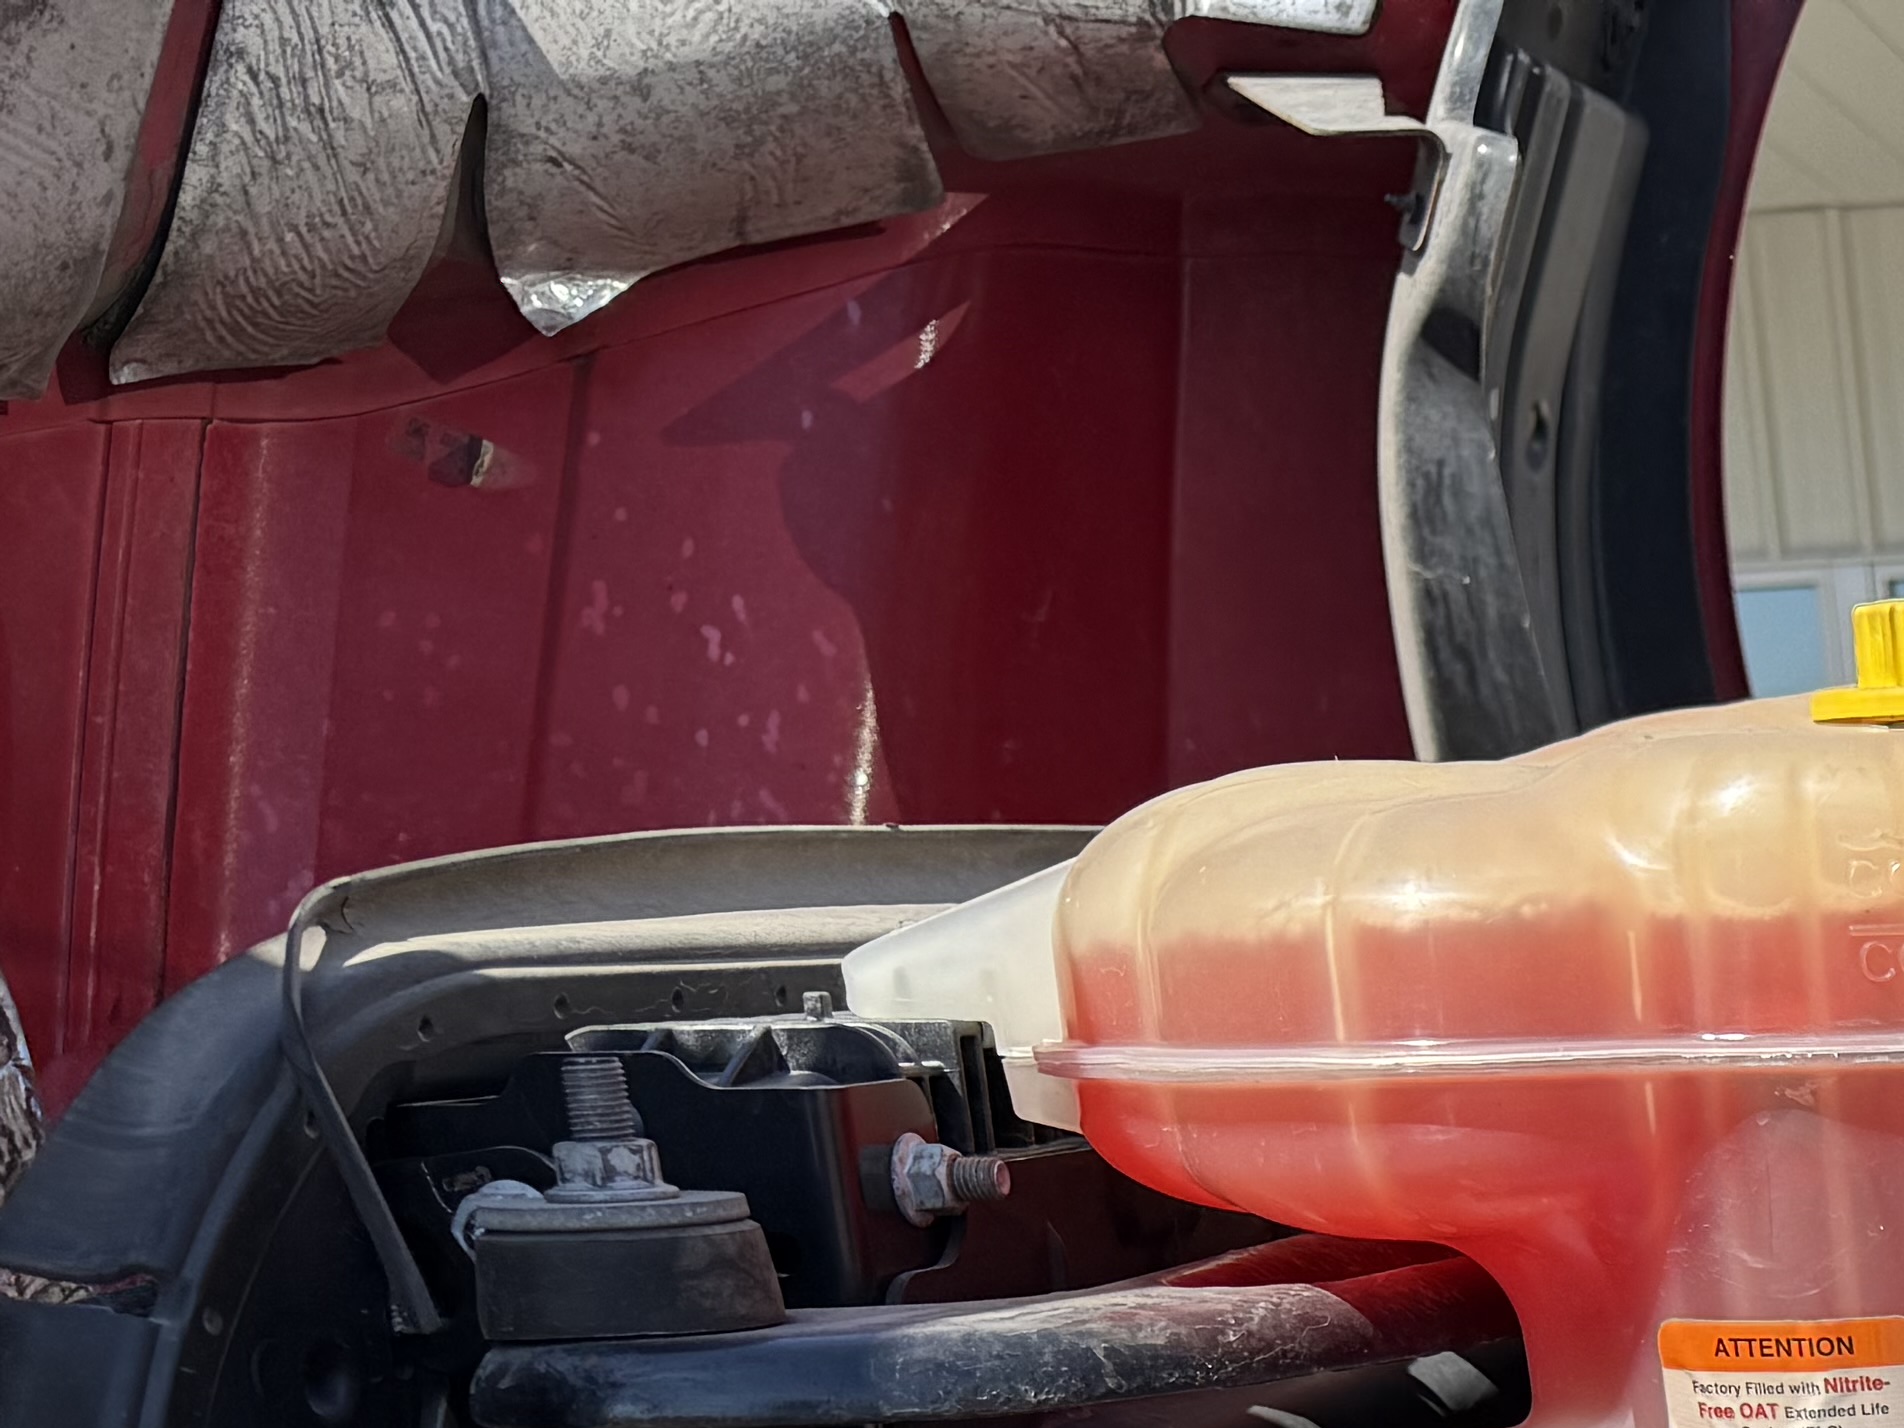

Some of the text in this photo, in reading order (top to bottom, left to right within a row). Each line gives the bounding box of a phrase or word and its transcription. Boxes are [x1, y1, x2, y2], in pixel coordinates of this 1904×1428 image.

[1714, 1336, 1855, 1358] ATTENTION
[1692, 1375, 1891, 1398] Factory Filled with Nitrite-
[1698, 1402, 1890, 1421] Free OAT Extended Life
